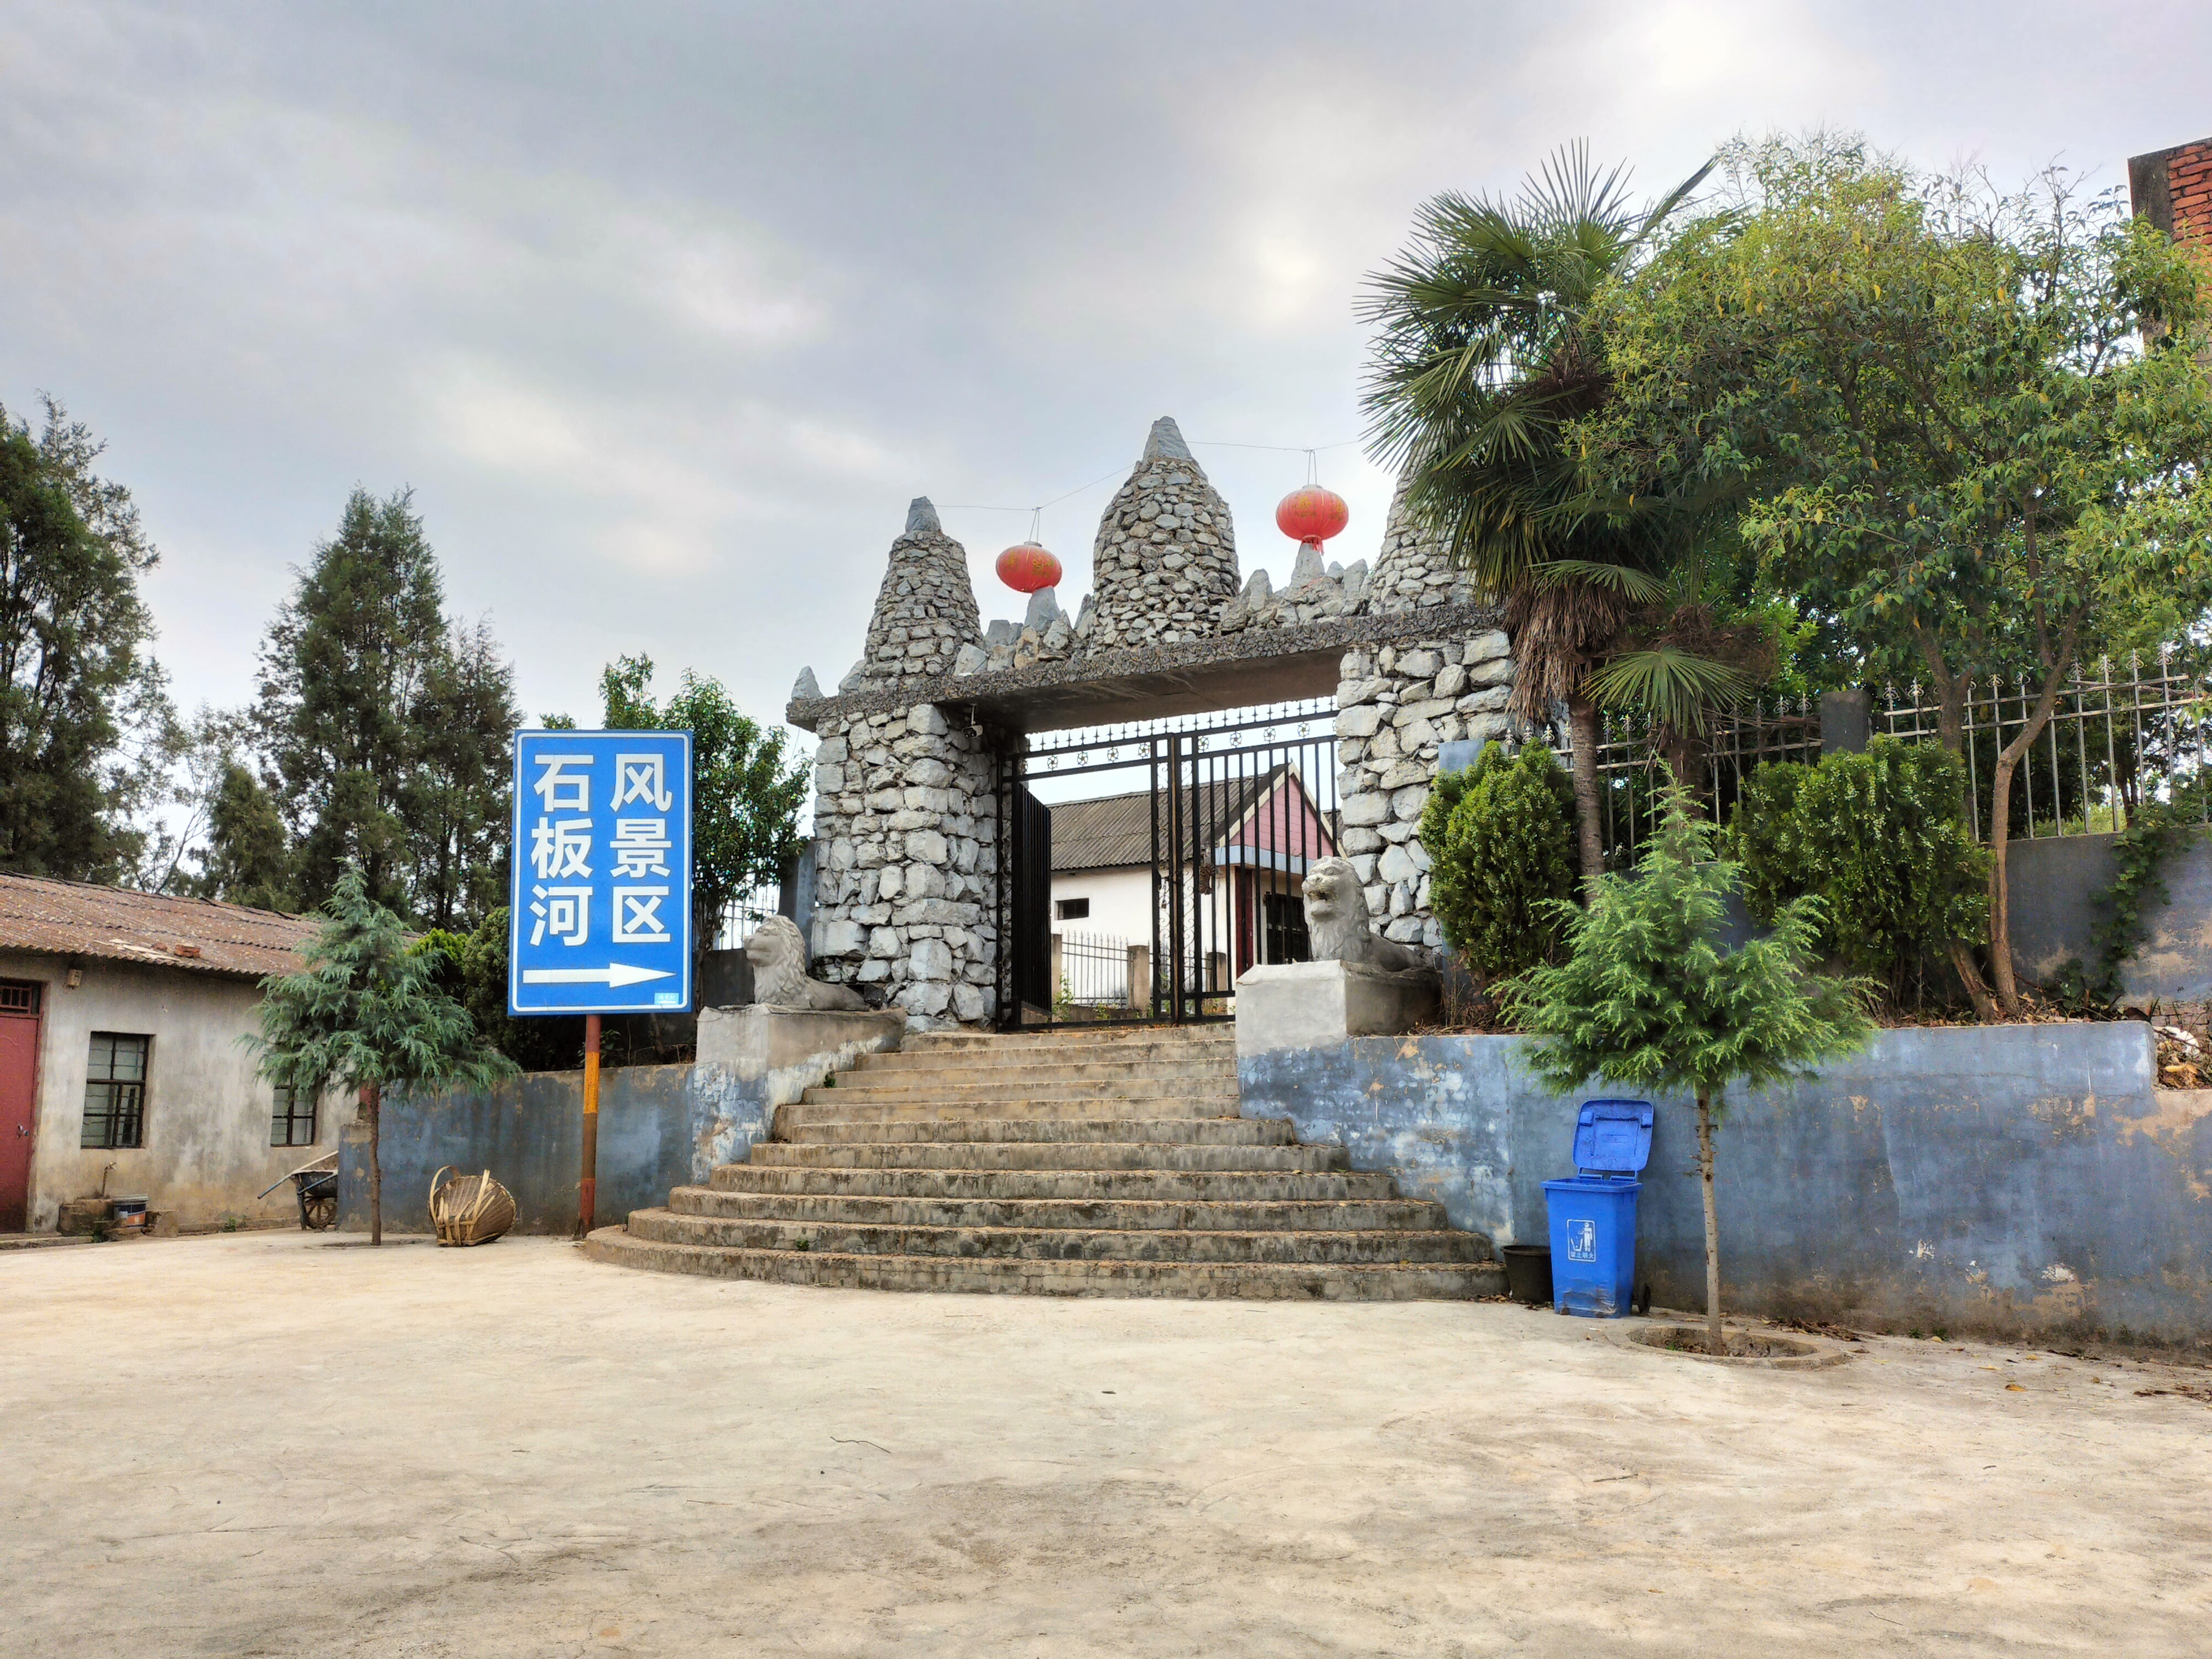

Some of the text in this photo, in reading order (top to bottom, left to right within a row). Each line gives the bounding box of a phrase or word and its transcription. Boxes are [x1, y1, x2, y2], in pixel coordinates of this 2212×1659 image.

[529, 755, 594, 946] 石板河
[609, 754, 672, 943] 风景区
